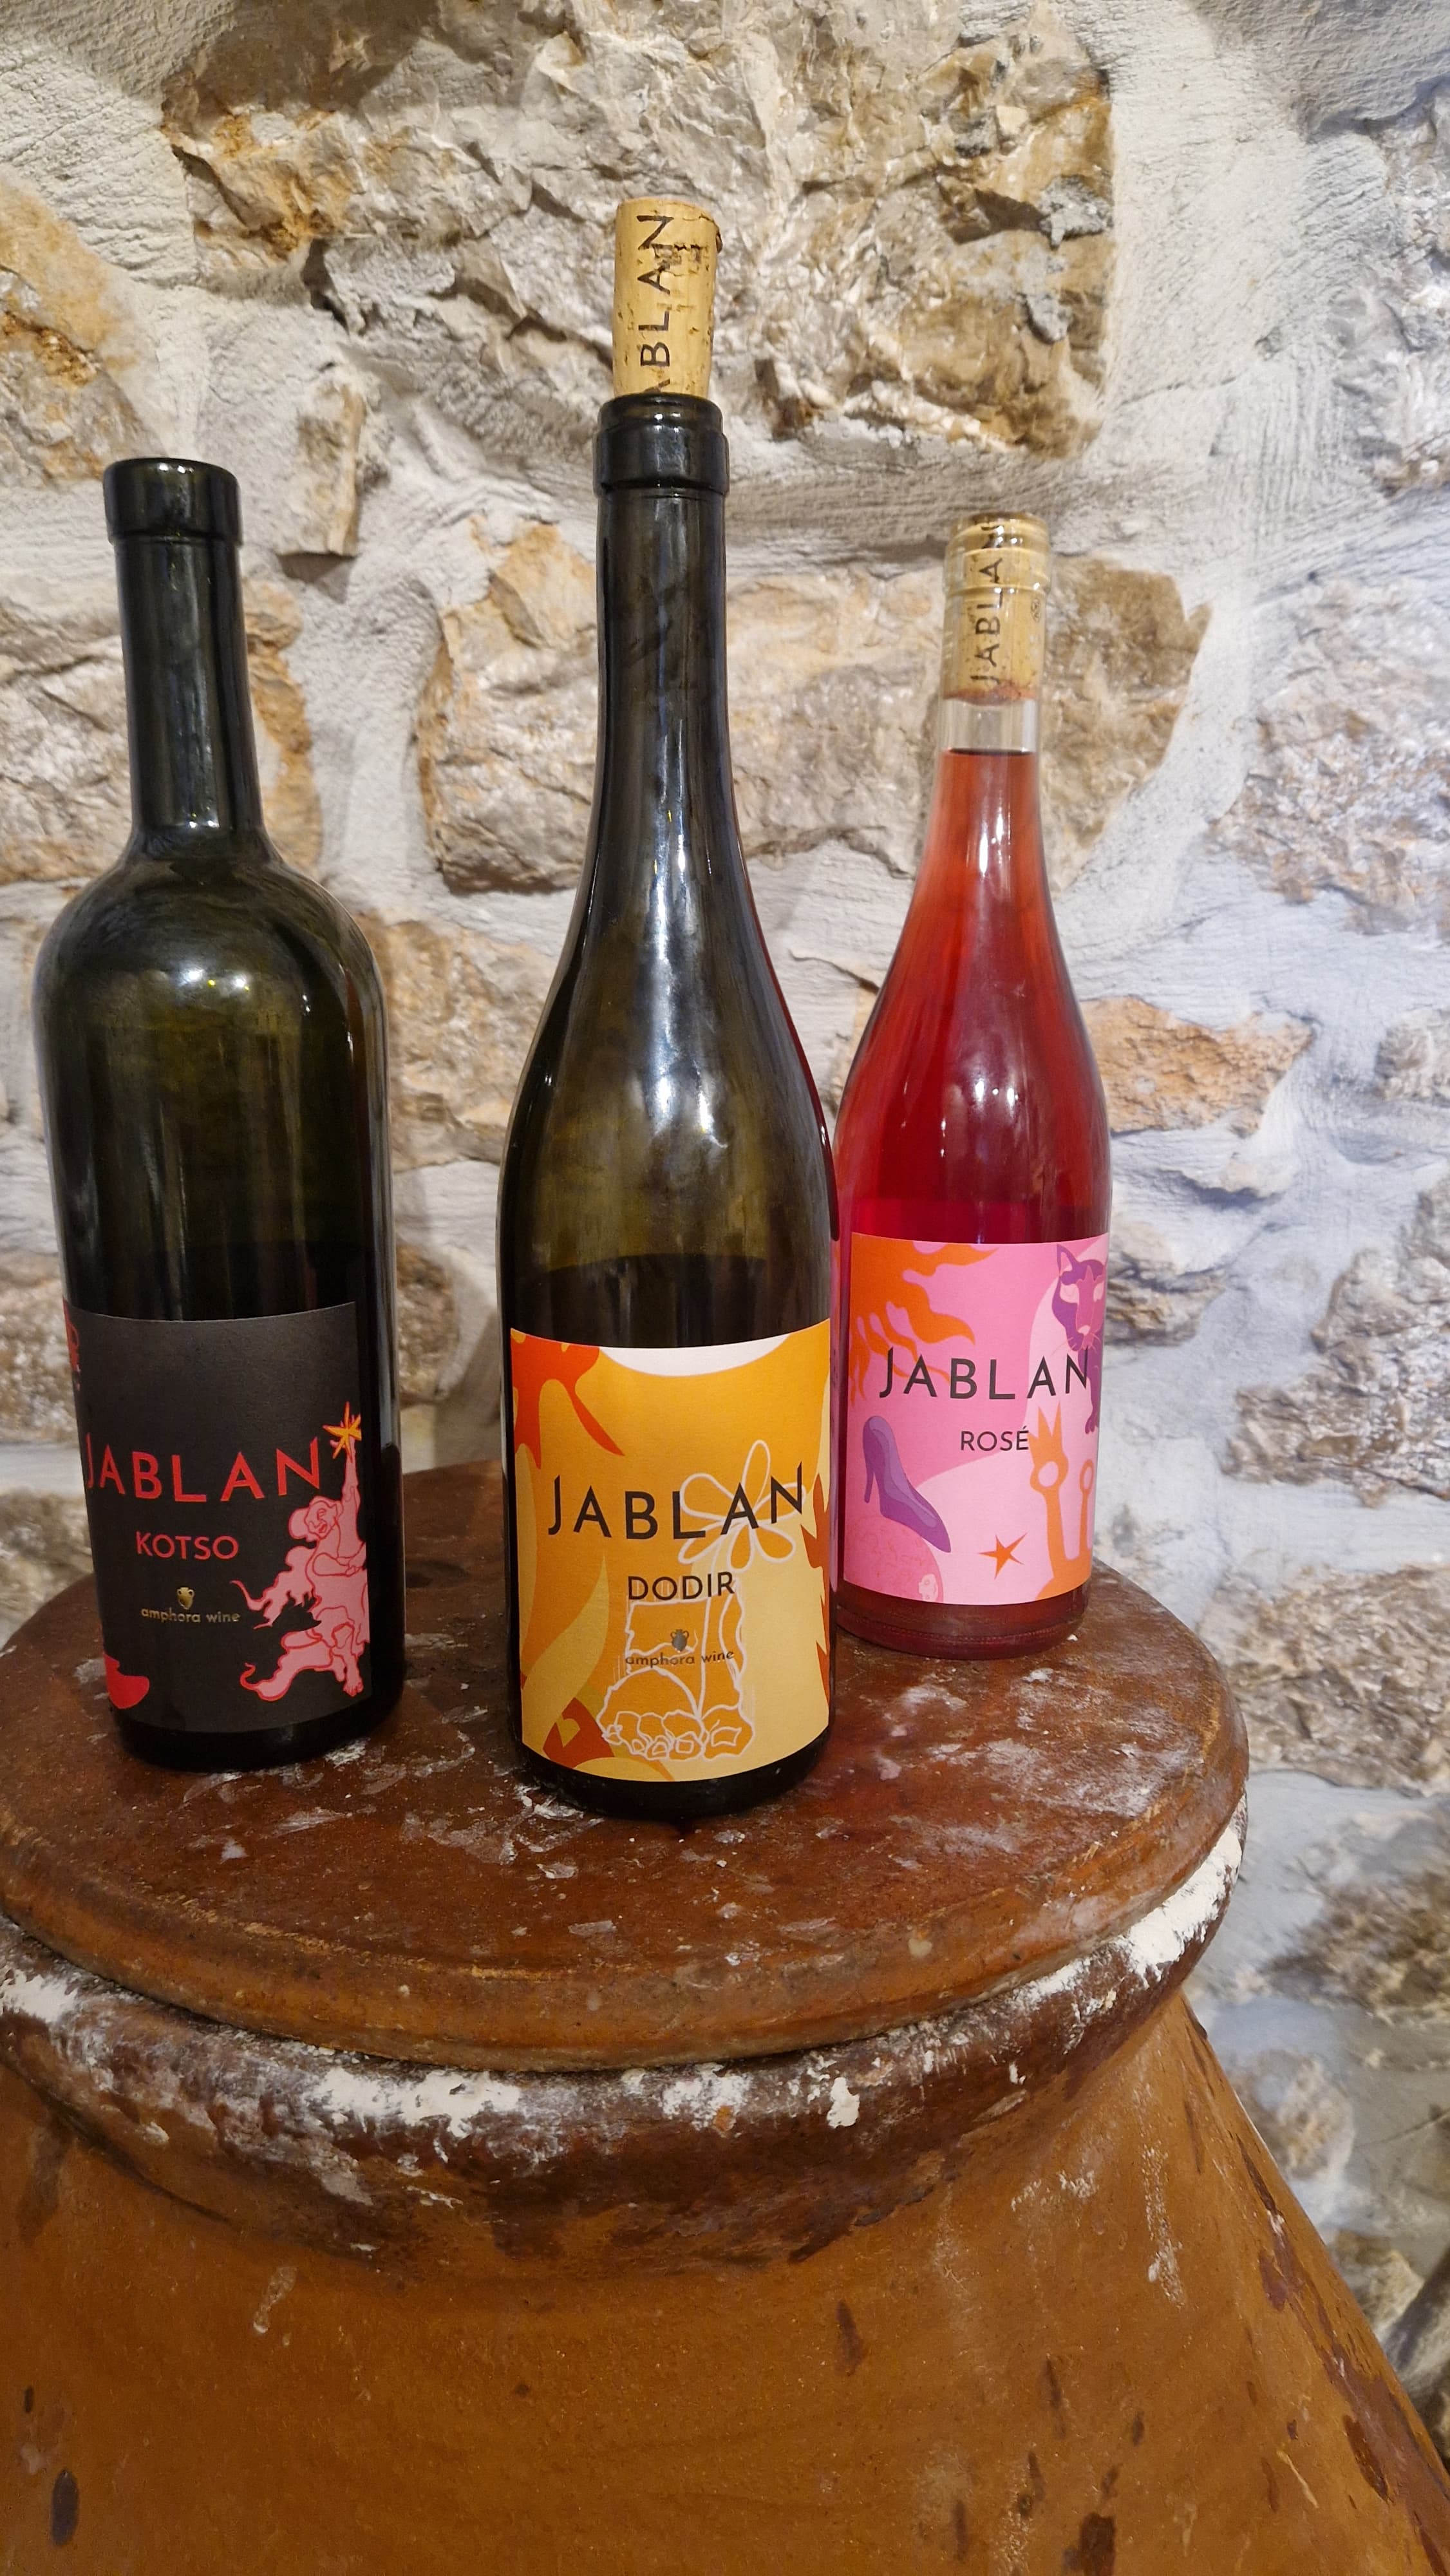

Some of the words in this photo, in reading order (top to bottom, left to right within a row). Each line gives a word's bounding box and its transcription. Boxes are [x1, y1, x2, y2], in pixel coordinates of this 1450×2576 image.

[880, 1347, 1089, 1399] JABLAN
[961, 1425, 1030, 1452] ROSÉ
[86, 1432, 320, 1502] JABLAN
[548, 1461, 802, 1539] JABLAN
[136, 1531, 239, 1559] KOTSO
[628, 1571, 735, 1600] DODIR
[141, 1607, 201, 1622] amphora
[206, 1611, 241, 1622] wine
[625, 1653, 695, 1668] amphora
[701, 1651, 735, 1663] wine
